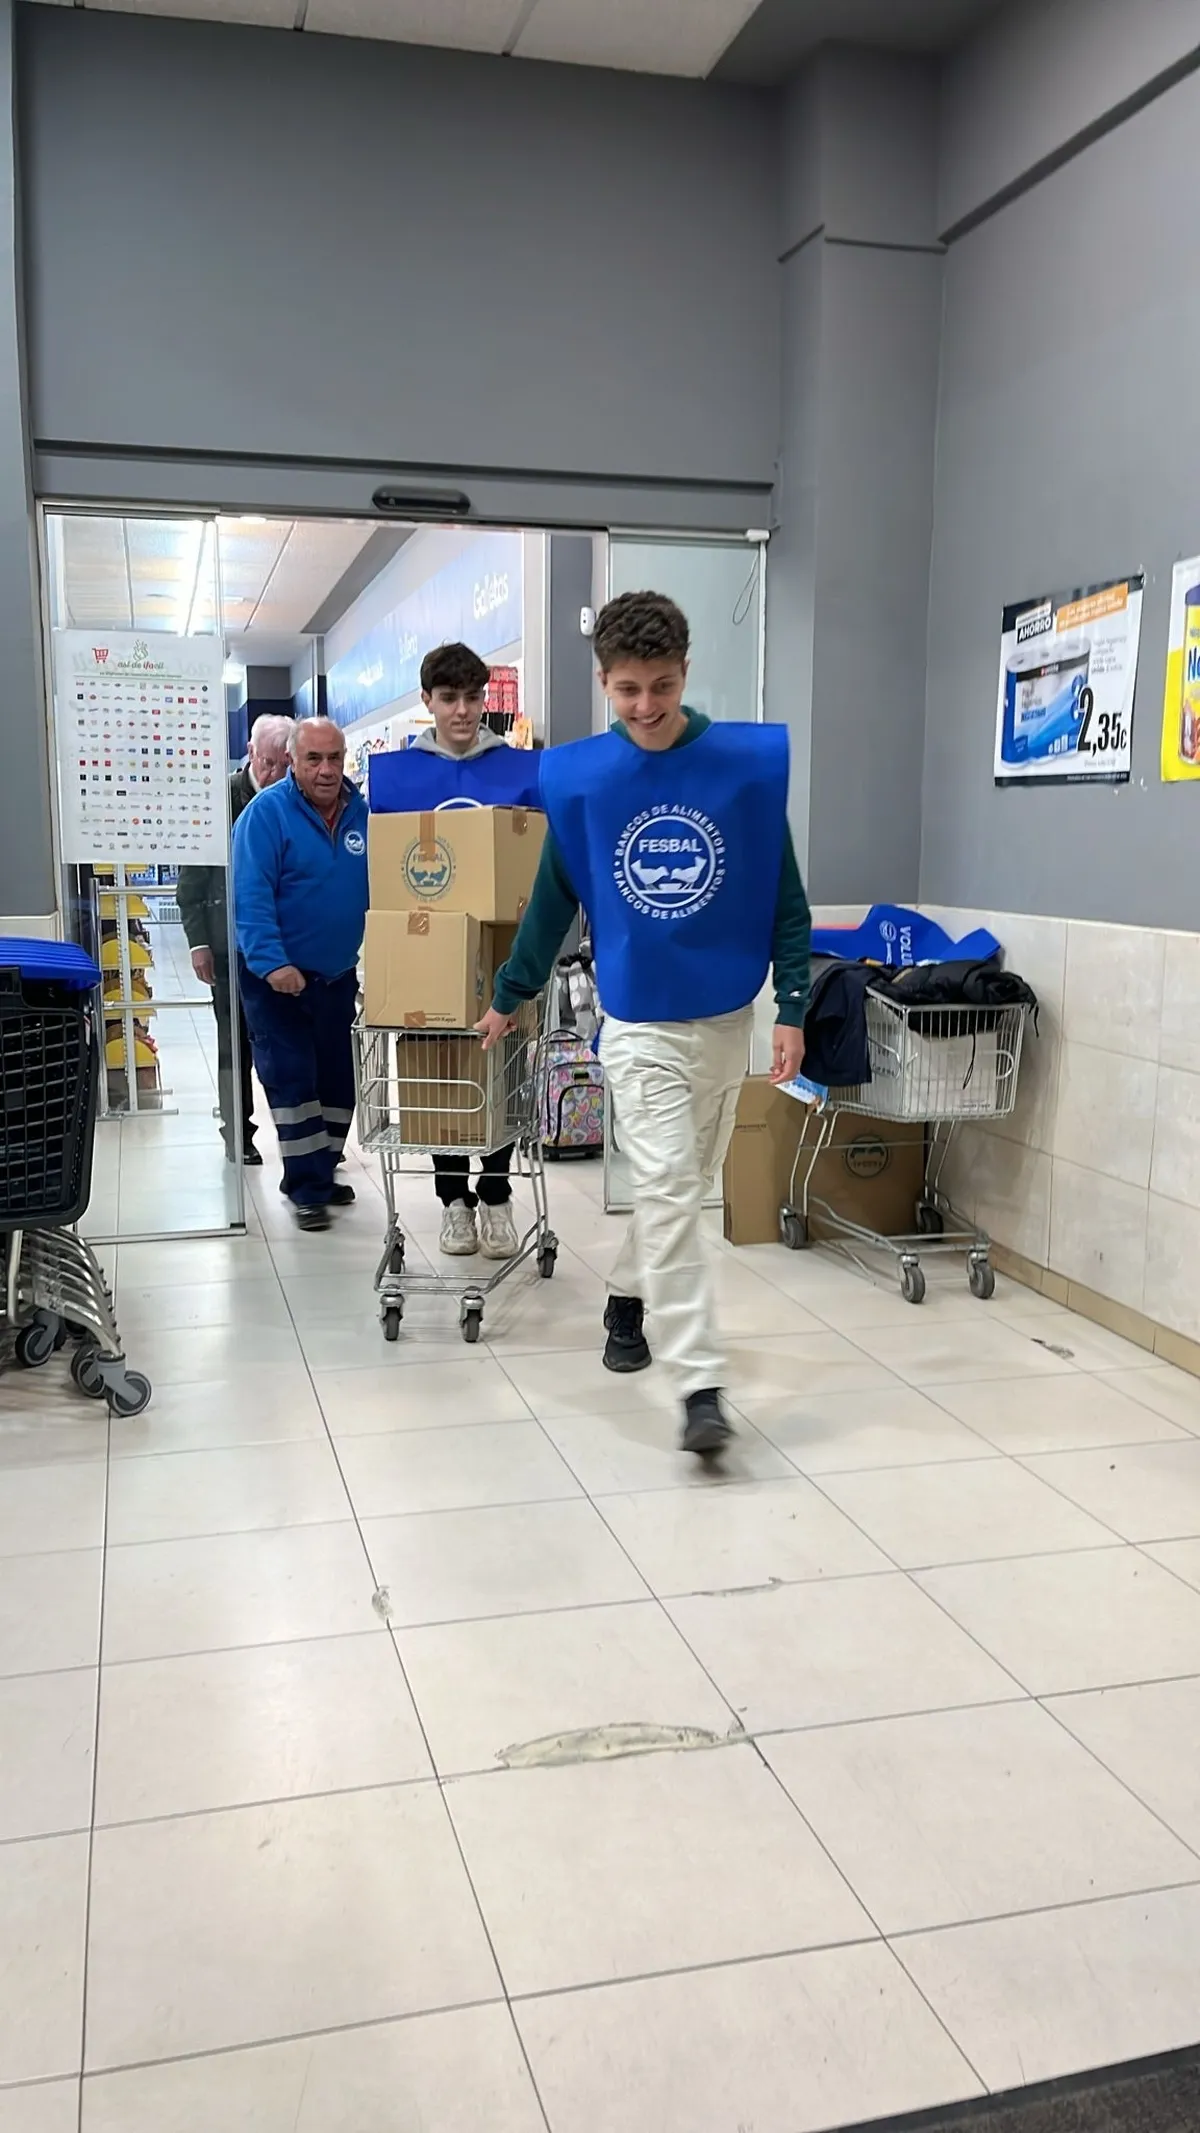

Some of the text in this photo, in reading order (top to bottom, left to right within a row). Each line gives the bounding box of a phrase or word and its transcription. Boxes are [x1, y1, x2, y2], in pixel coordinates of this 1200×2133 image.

[1018, 616, 1052, 642] AHORRO
[1078, 686, 1128, 757] 2,35€
[614, 803, 726, 856] BANCOS DE ALIMENTOS
[638, 837, 703, 854] FESBAL
[612, 868, 726, 920] BANCOS DE ALIMENTOS
